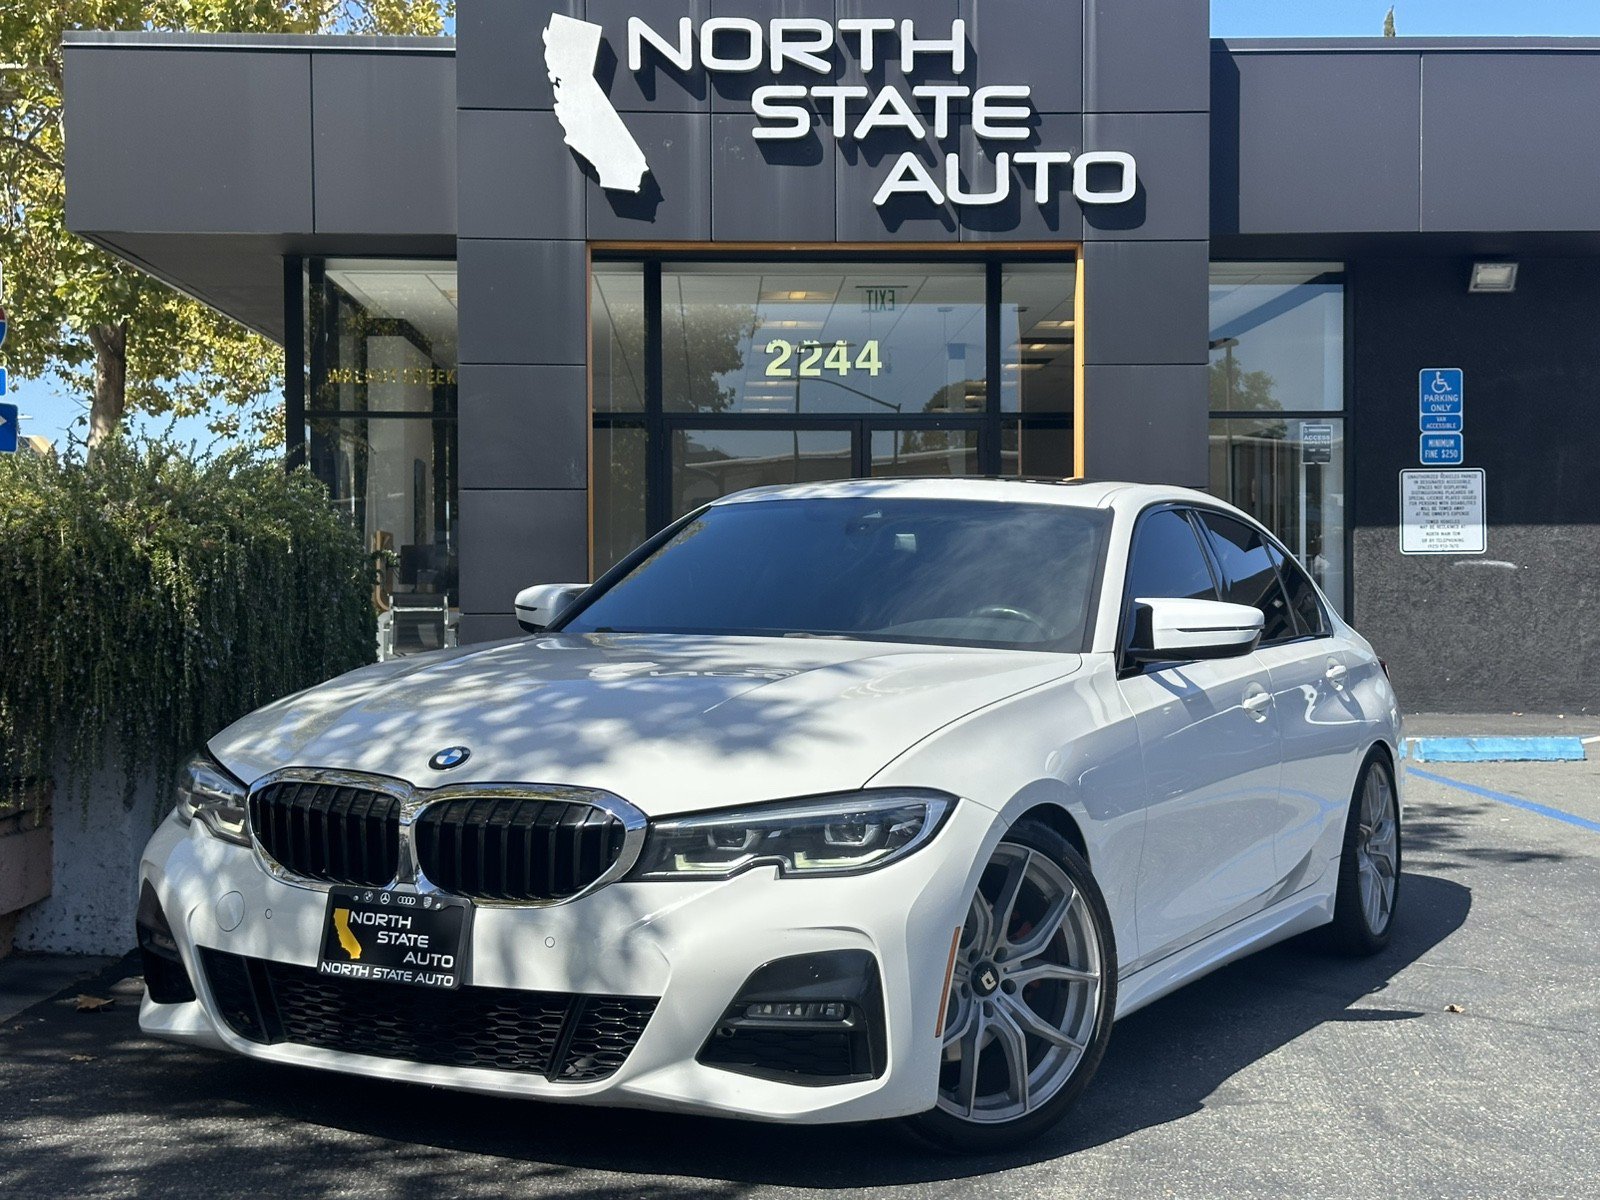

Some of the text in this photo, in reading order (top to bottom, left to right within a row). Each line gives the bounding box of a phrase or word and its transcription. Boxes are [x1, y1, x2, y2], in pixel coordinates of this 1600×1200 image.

[627, 16, 966, 75] NORTH
[751, 85, 1031, 140] STATE
[873, 151, 1137, 206] AUTO
[765, 339, 882, 377] 2244
[1424, 394, 1459, 402] PARKING
[1430, 404, 1452, 412] ONLY
[1428, 439, 1455, 447] MINIMUM
[1424, 449, 1459, 459] FINE $250
[350, 911, 412, 930] NORTH
[376, 931, 429, 948] STATE
[403, 951, 454, 968] AUTO
[321, 961, 454, 987] NORTH STATE AUTO
